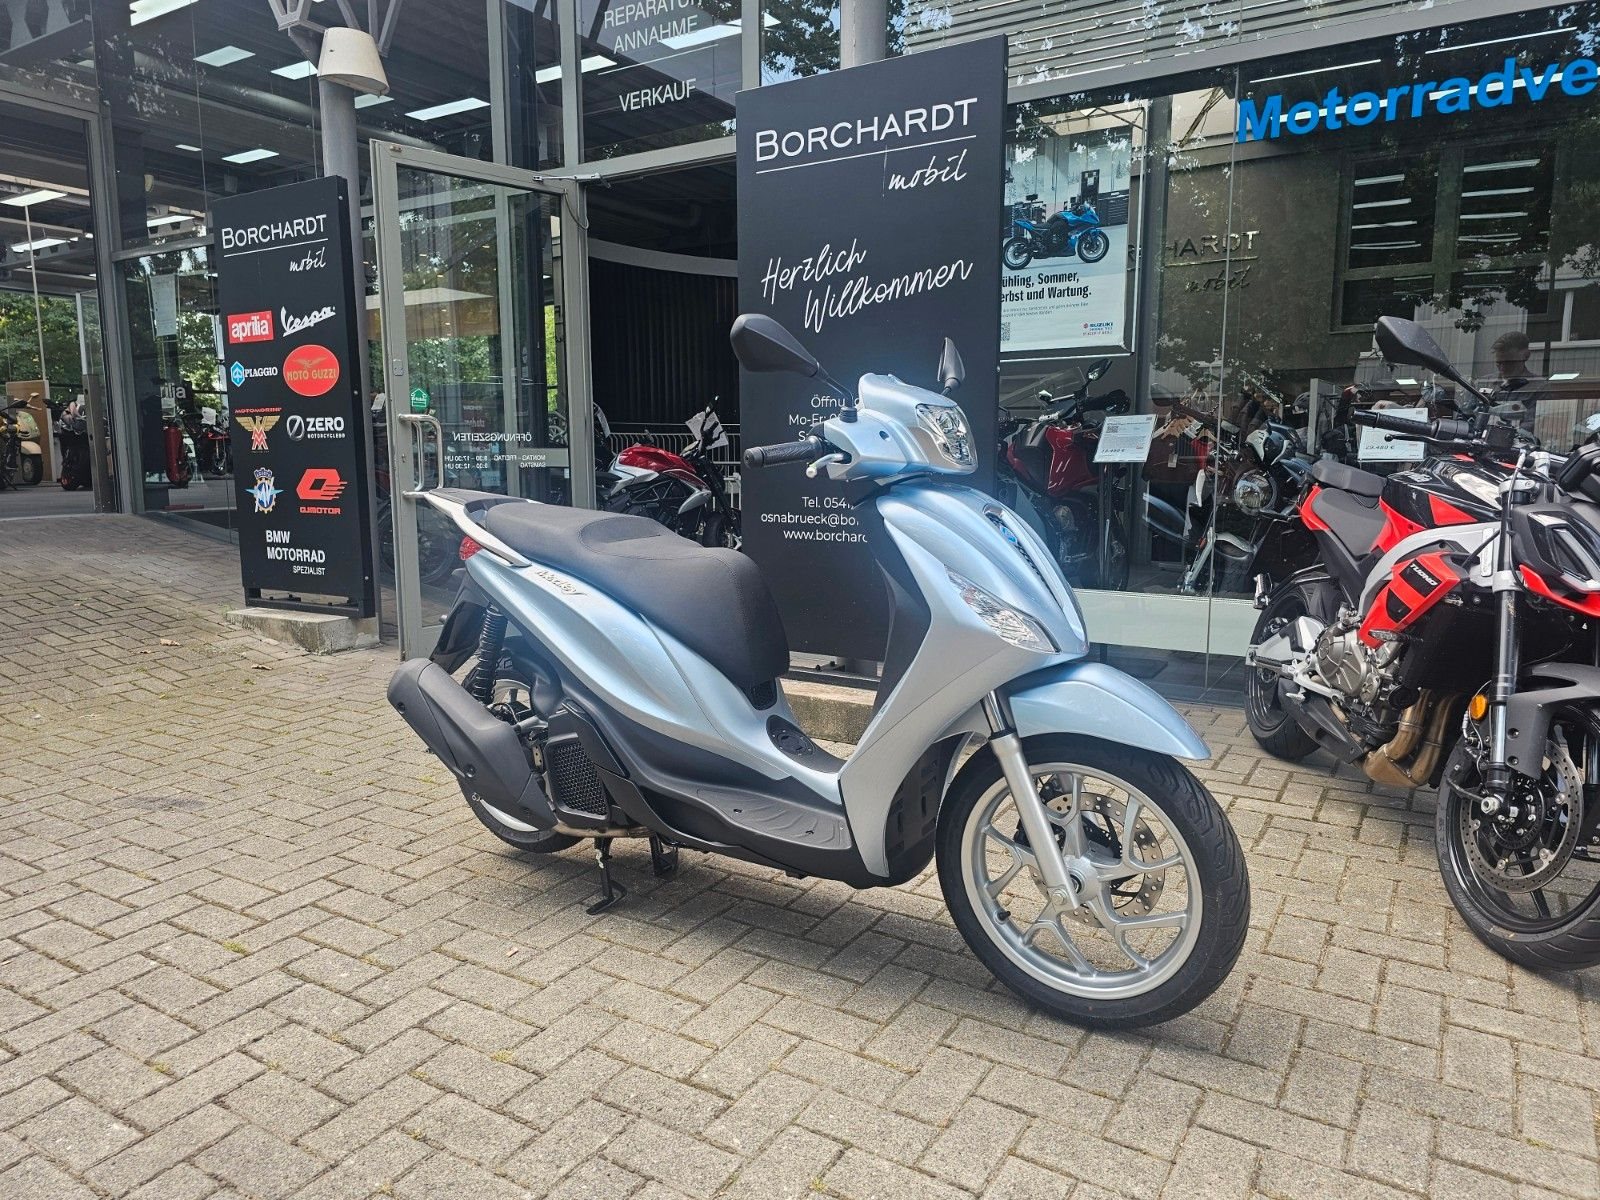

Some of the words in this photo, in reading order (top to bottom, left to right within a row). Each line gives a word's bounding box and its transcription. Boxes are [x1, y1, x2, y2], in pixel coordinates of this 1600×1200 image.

[604, 0, 702, 29] REPARATU
[613, 14, 698, 54] ANNAHME
[618, 78, 697, 112] VERKAUF
[1237, 57, 1600, 144] Motorradve
[755, 97, 978, 162] BORCHARDT
[888, 149, 967, 190] mobil
[221, 214, 327, 249] BORCHARDT
[289, 246, 327, 272] mobil
[760, 238, 867, 305] Herzlich
[1002, 274, 1034, 289] ühling,
[1038, 271, 1080, 285] Sommer,
[804, 259, 974, 333] Willkommen
[1000, 290, 1025, 303] erbst
[1026, 288, 1045, 300] und
[1048, 285, 1092, 299] Wartung.
[231, 315, 269, 342] aprilia
[280, 305, 337, 338] Vespa
[244, 366, 278, 378] PIAGGIO
[286, 370, 310, 381] MOTO
[311, 368, 337, 380] GUZZI
[160, 382, 187, 399] rilia
[306, 416, 345, 432] ZERO
[801, 496, 821, 508] Tel.
[823, 497, 854, 509] 054
[760, 512, 859, 528] osnabrueck@bo
[265, 530, 291, 543] BMW
[266, 546, 326, 563] MOTORRAD
[292, 565, 326, 576] SPEZIALIST
